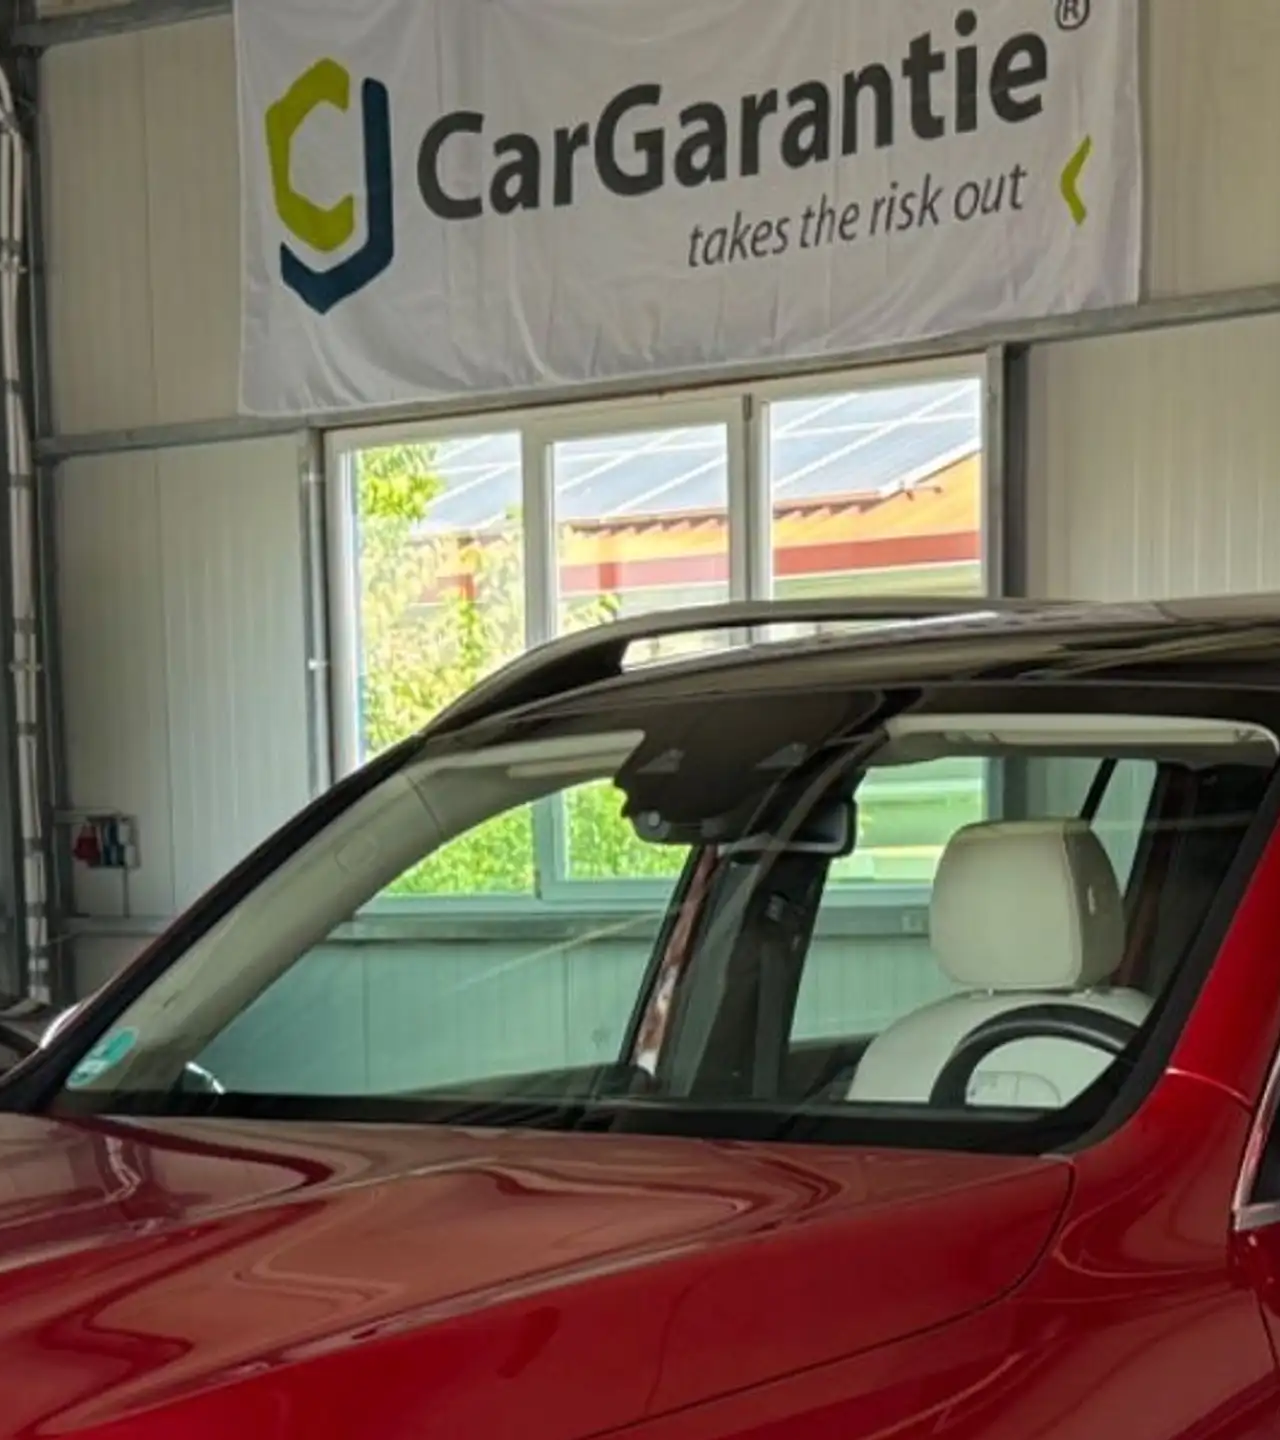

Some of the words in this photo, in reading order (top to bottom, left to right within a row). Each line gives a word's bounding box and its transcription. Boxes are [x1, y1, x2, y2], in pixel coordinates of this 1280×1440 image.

[687, 211, 791, 268] takes
[799, 193, 861, 249] the
[869, 172, 945, 238] risk
[954, 163, 1028, 222] out
